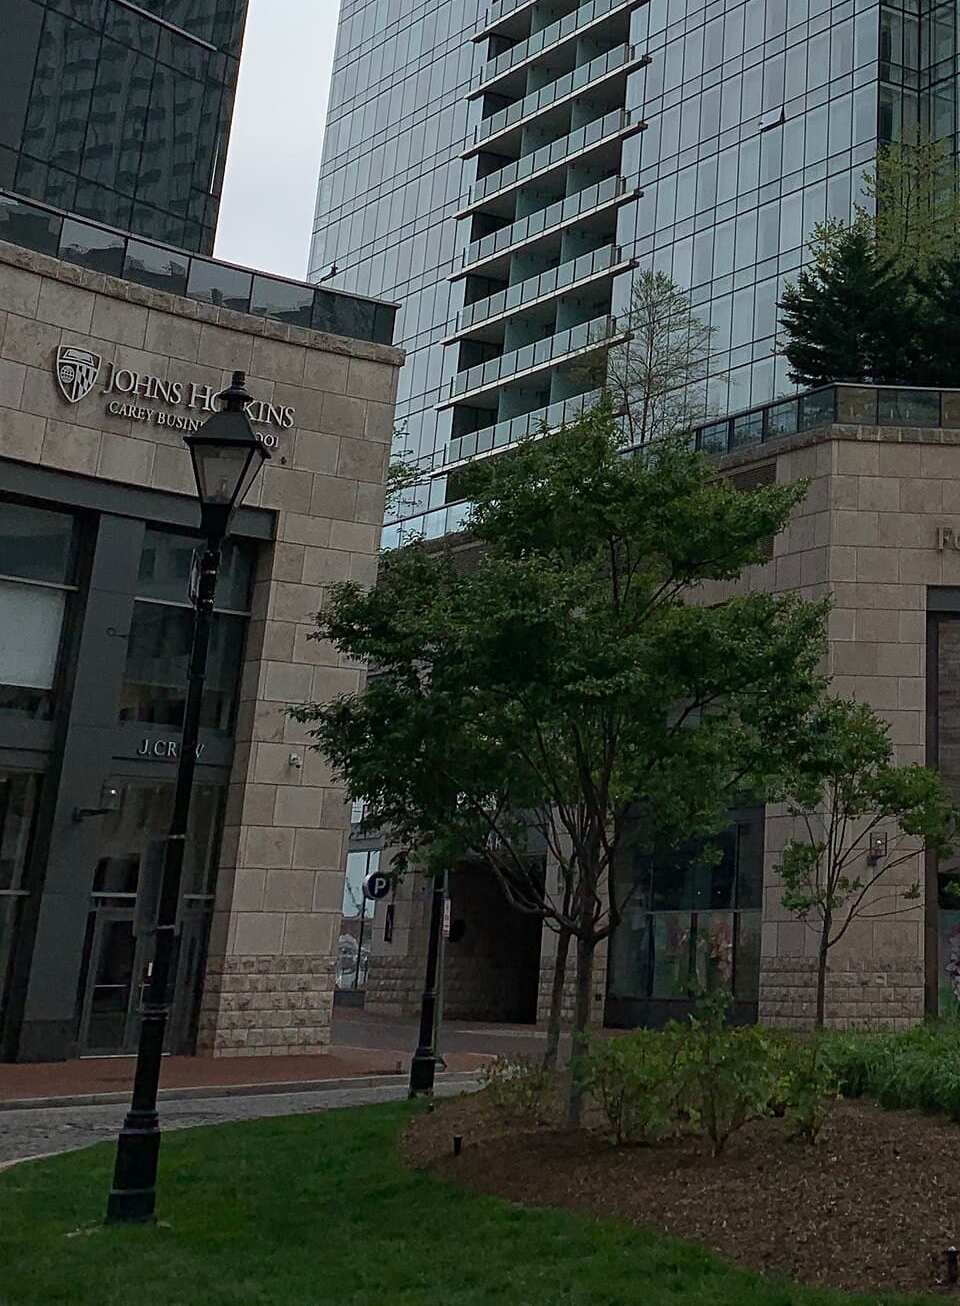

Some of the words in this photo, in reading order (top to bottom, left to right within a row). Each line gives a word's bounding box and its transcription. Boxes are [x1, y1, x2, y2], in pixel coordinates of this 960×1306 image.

[103, 362, 183, 405] JOHNS
[188, 382, 296, 428] HOKINS
[108, 401, 153, 422] CAREY
[374, 877, 387, 895] P
